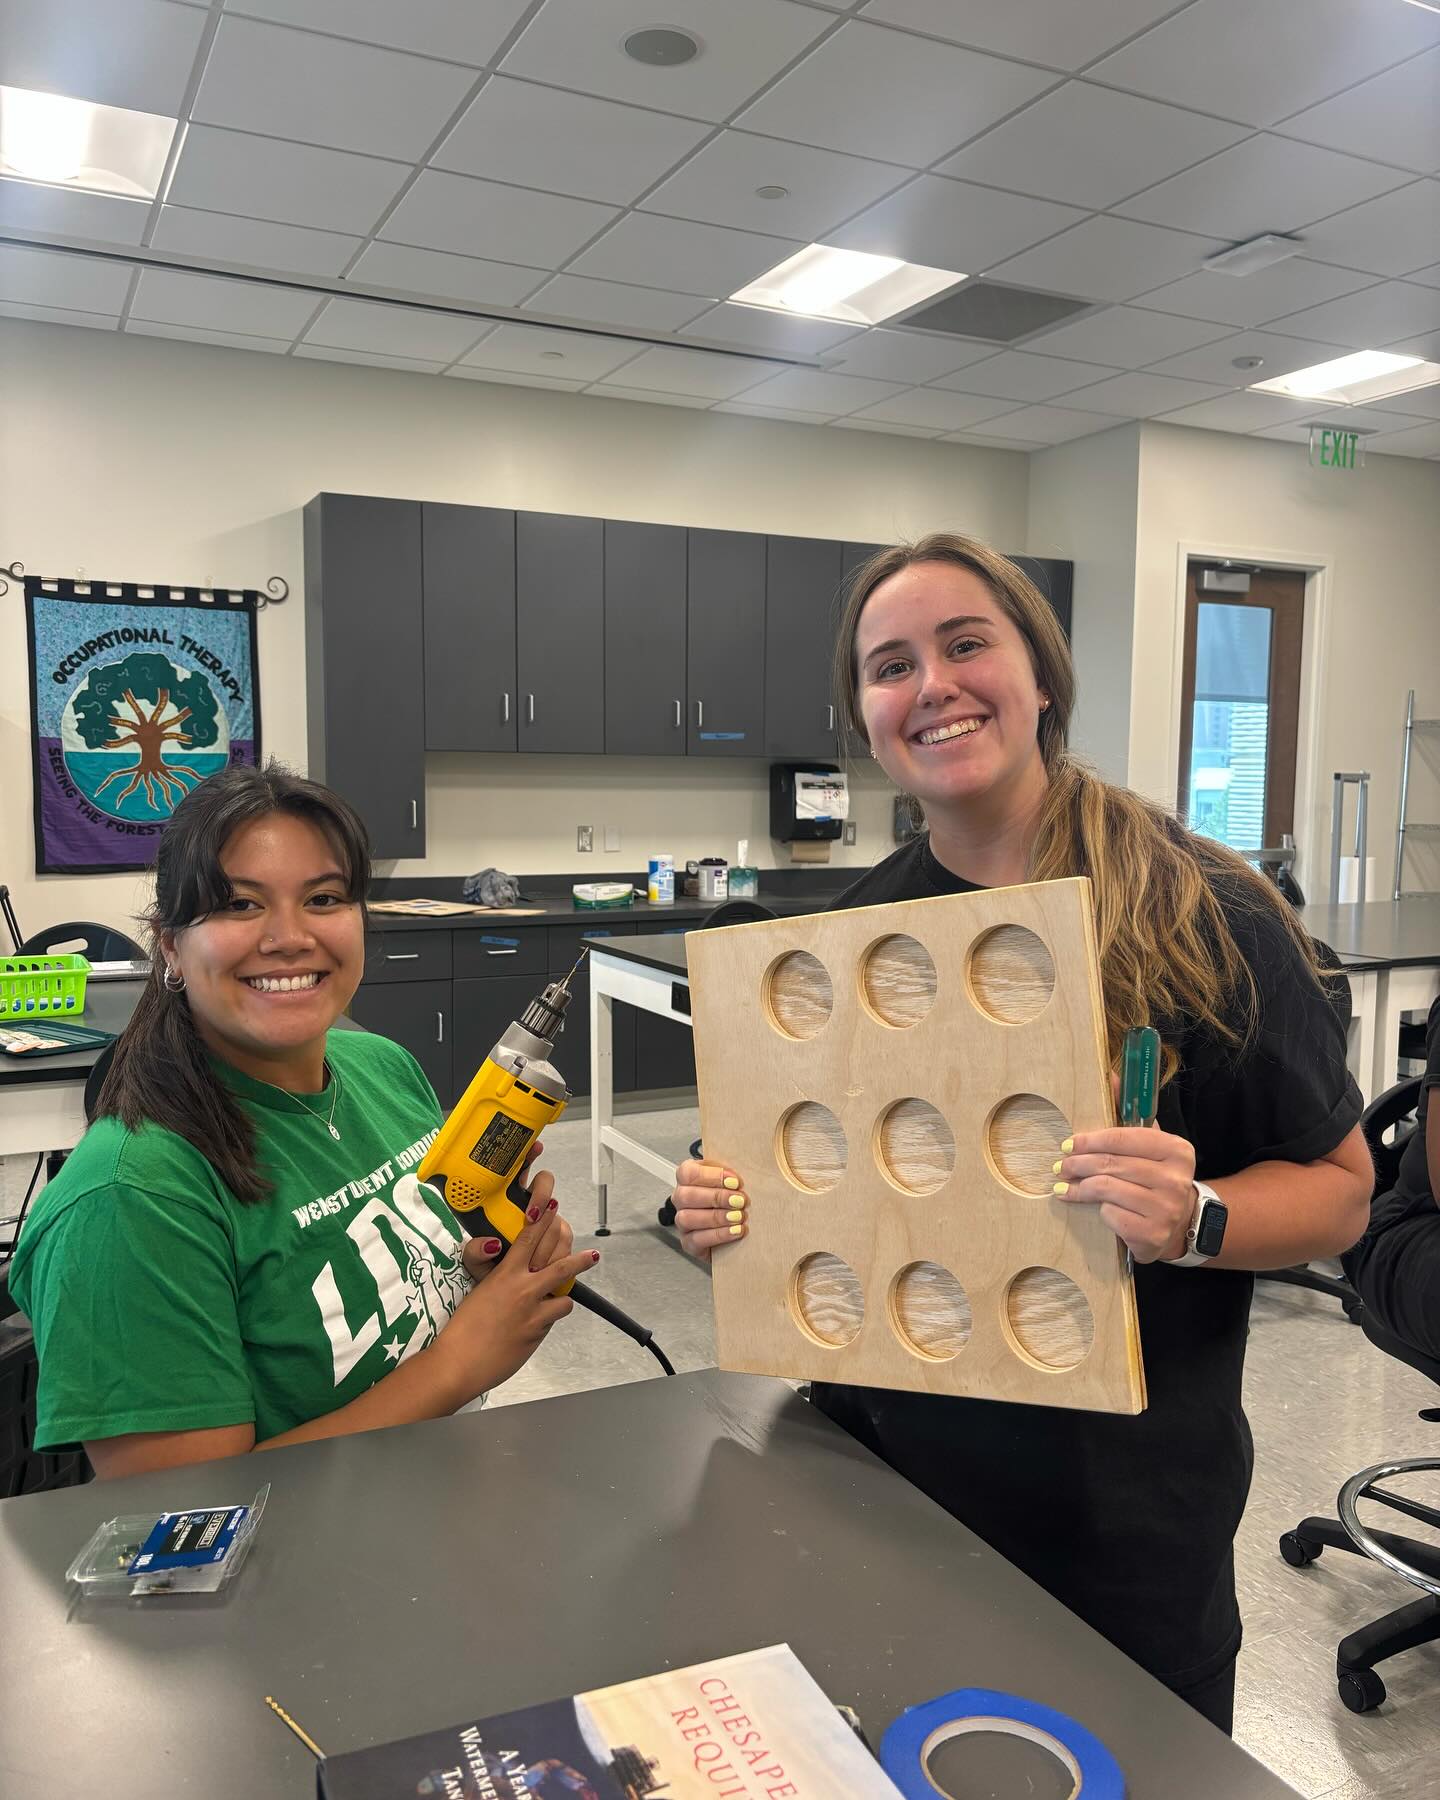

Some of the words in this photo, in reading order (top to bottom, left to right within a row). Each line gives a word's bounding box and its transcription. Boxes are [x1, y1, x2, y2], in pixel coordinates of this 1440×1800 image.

[1321, 431, 1358, 469] EXIT
[52, 628, 174, 685] OCCUPATIONAL
[179, 634, 245, 704] THERAPY
[48, 747, 77, 799] SEEING
[75, 799, 103, 825] THE
[105, 819, 166, 837] FOREST
[458, 1726, 499, 1800] WATERME
[498, 1750, 519, 1763] A
[671, 1706, 754, 1800] REQUI
[699, 1678, 798, 1800] CHESAPE
[441, 1766, 465, 1800] TAN
